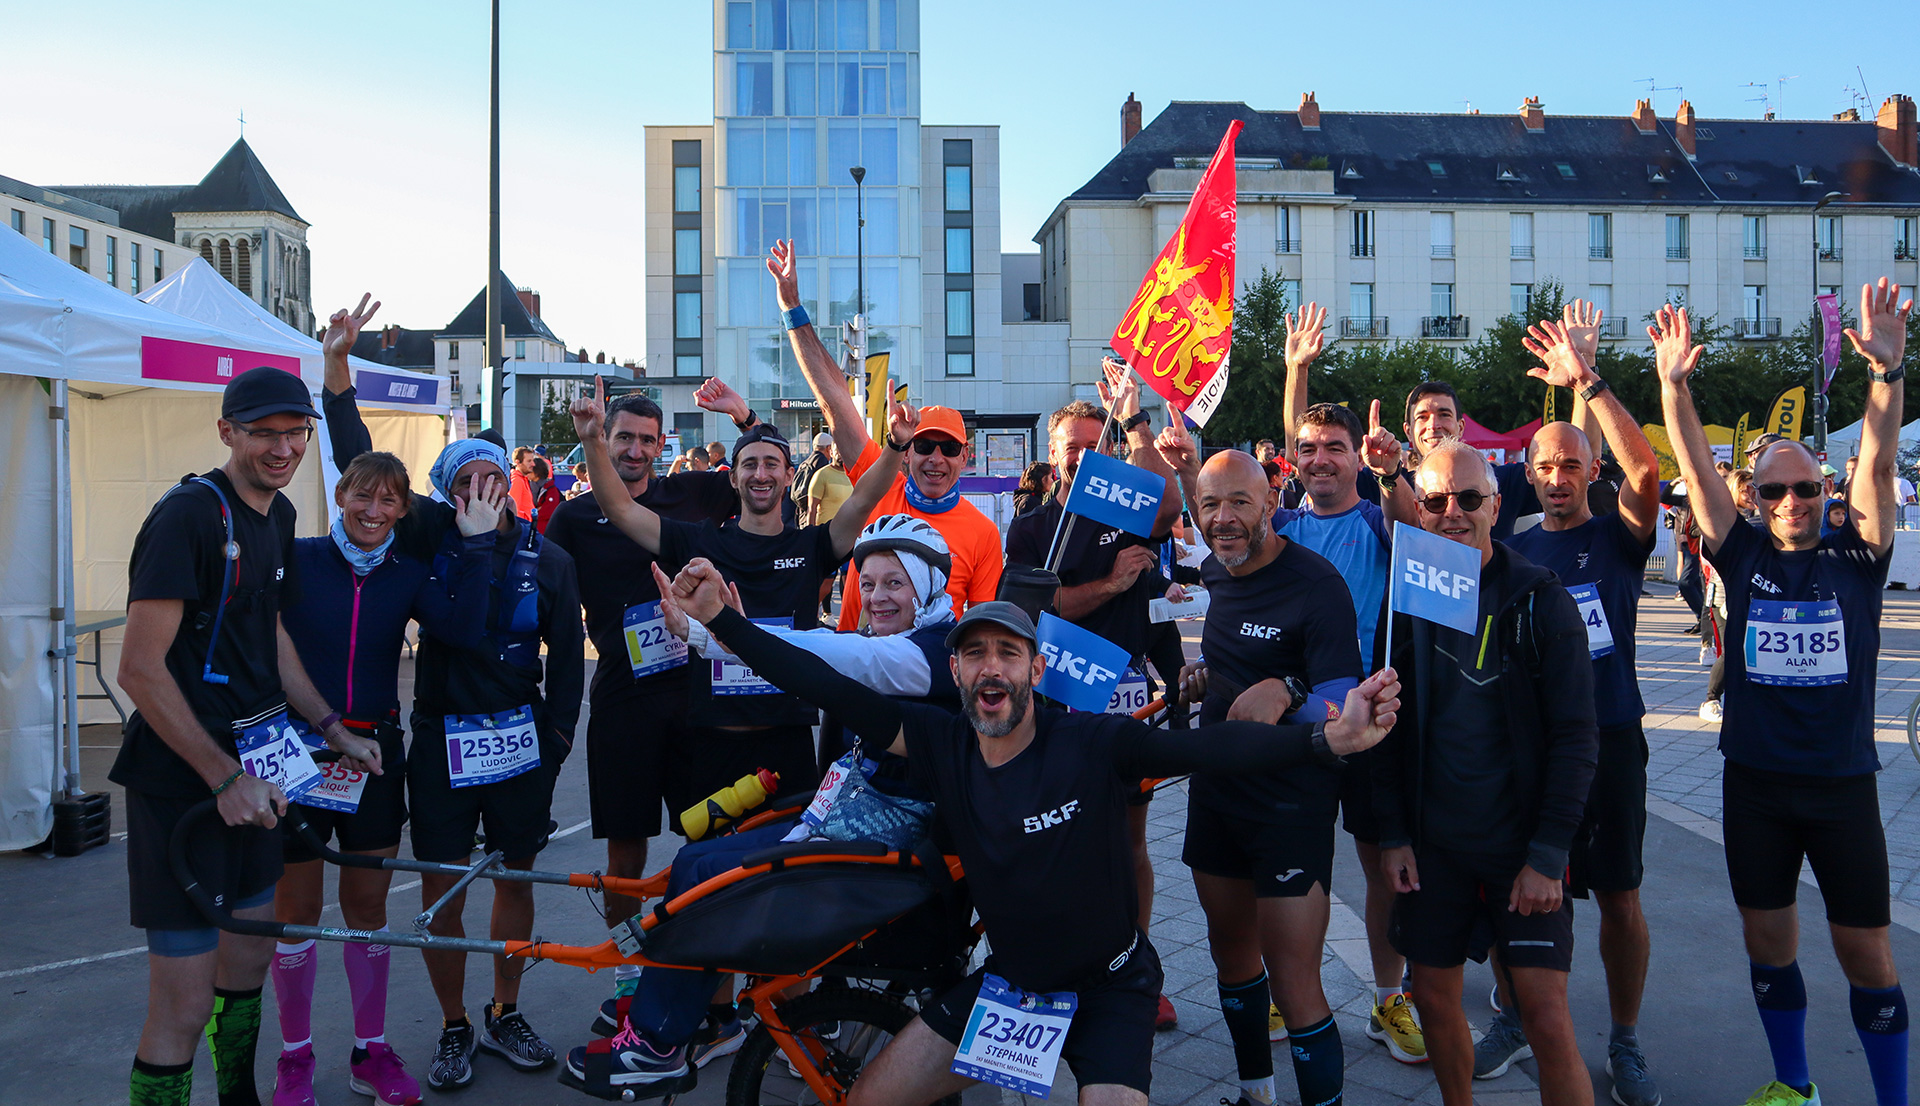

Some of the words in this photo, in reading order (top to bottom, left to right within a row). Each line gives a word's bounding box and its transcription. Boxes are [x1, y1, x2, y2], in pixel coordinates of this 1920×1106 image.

[789, 400, 813, 408] Hilton
[1084, 475, 1159, 512] SKF
[774, 557, 805, 571] SKF
[1404, 558, 1476, 600] SKF
[1751, 573, 1783, 594] SKF
[1586, 608, 1603, 629] 4
[1240, 622, 1281, 640] SKF
[1757, 630, 1841, 654] 23185
[1039, 641, 1118, 686] SKF
[1785, 657, 1818, 667] ALAN
[1109, 689, 1145, 709] 916
[462, 730, 534, 759] 25356
[255, 737, 301, 781] 254
[481, 752, 522, 768] LUDOVIC
[322, 760, 363, 784] 355
[318, 781, 351, 793] LIQUE
[1023, 799, 1079, 834] SKF
[977, 1012, 1063, 1053] 23407
[985, 1044, 1039, 1068] STEPHANE
[983, 1057, 1007, 1070] MAGNETIC
[1006, 1063, 1044, 1080] MECHATRONICS
